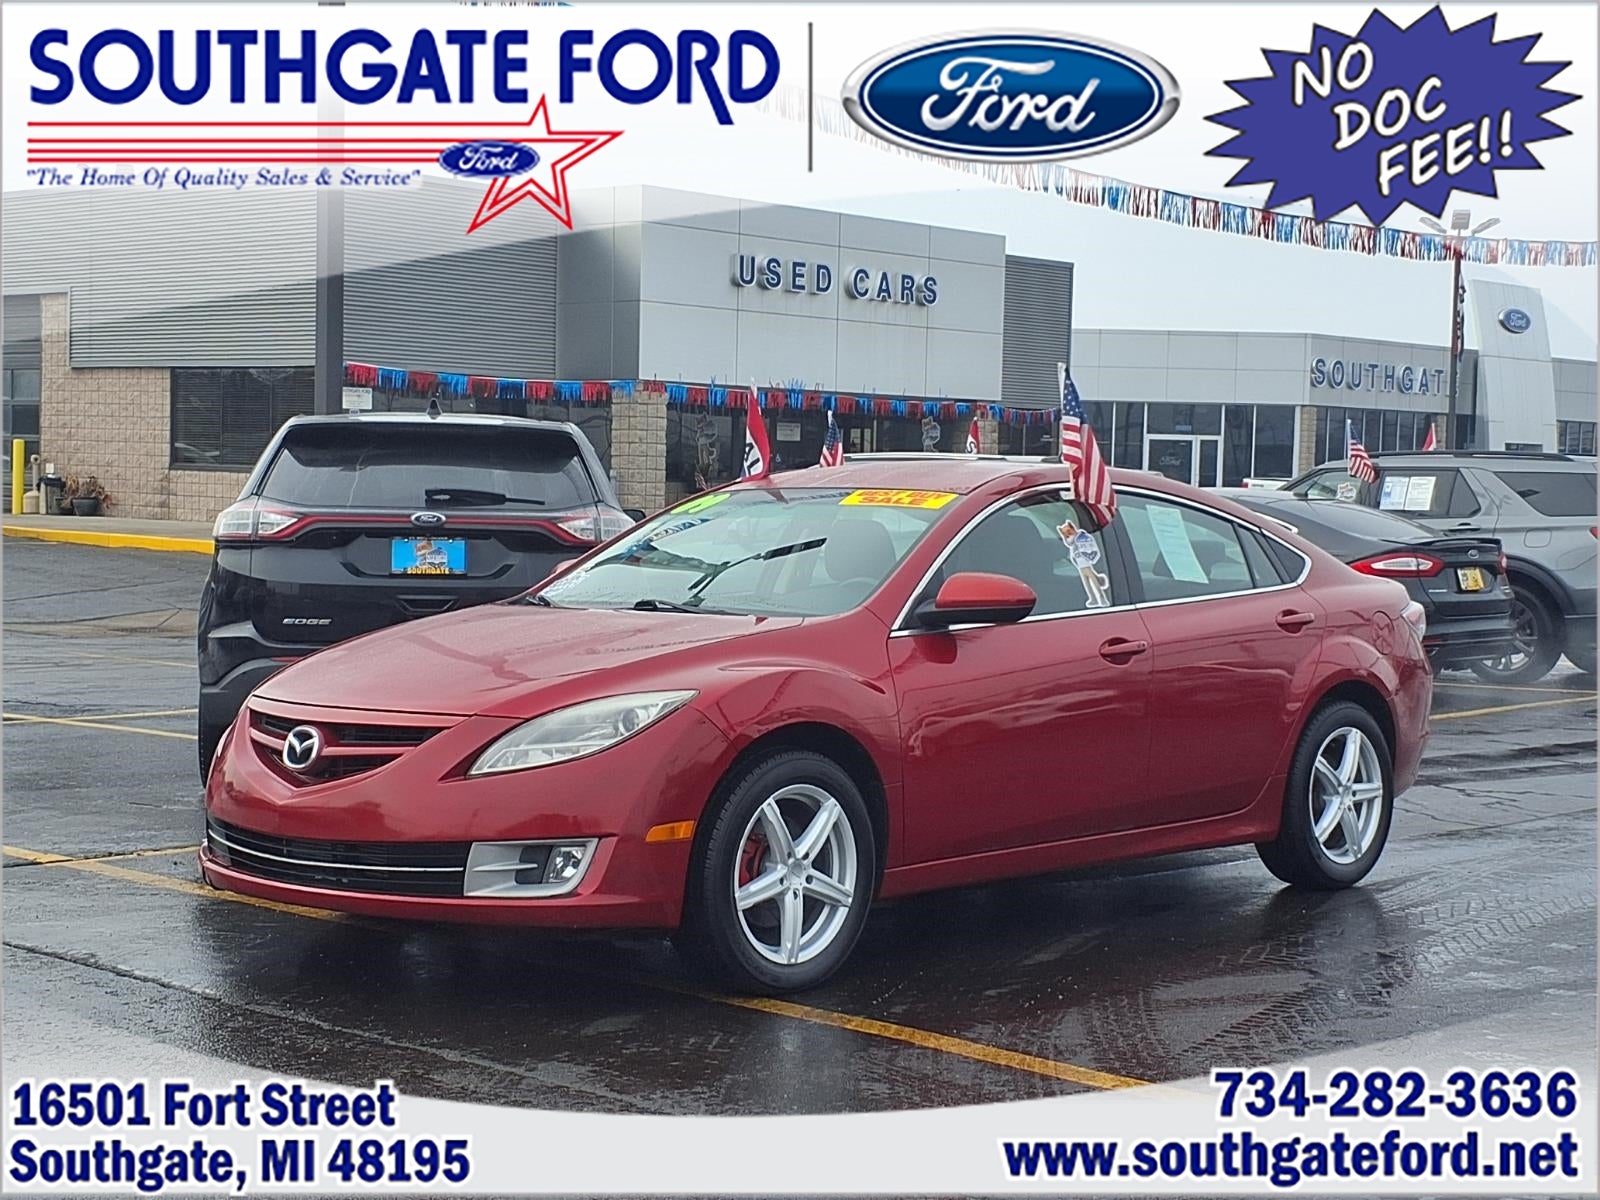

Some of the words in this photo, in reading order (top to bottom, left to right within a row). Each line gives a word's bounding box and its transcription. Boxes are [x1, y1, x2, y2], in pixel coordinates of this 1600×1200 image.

[737, 254, 833, 294] USED
[852, 267, 938, 305] CARS
[1313, 358, 1446, 395] SOUTHGAT
[858, 496, 928, 506] SALE
[406, 566, 450, 575] SOUTHGATE
